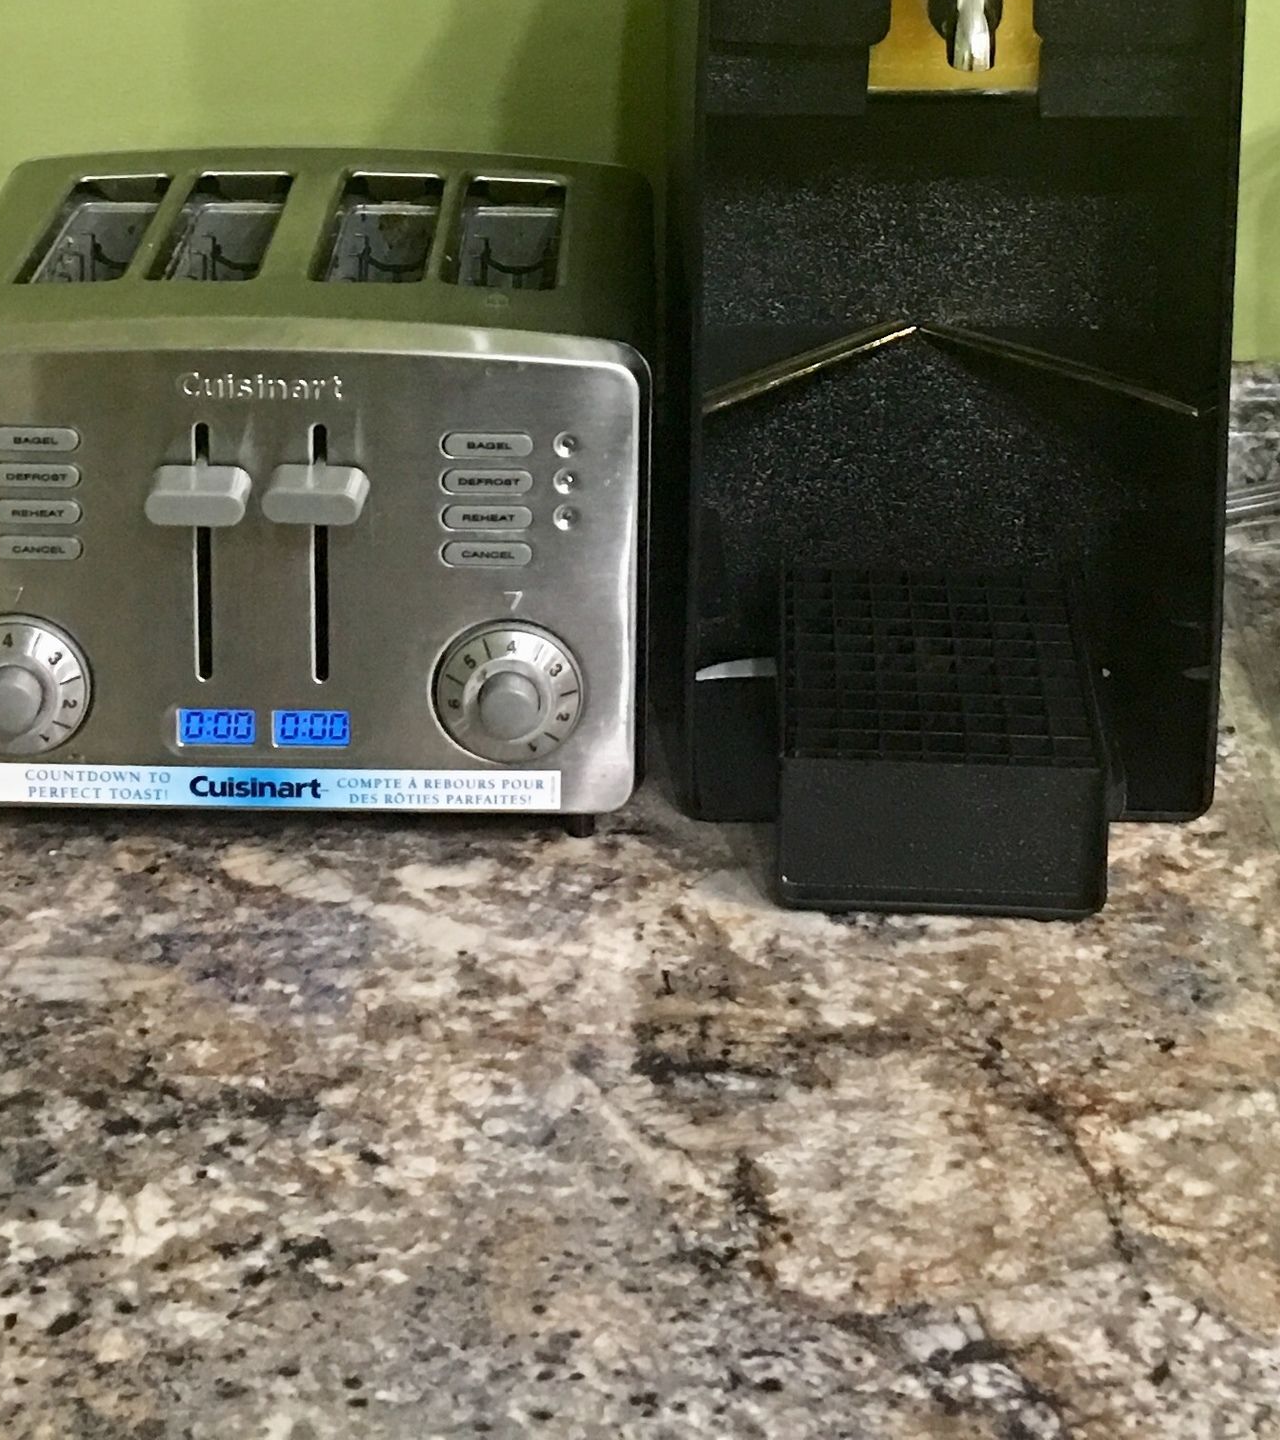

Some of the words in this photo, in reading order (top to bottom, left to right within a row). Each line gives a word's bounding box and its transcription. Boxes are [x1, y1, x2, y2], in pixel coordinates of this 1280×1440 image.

[176, 372, 342, 400] Cuisinart
[13, 436, 59, 445] BAGEL
[466, 441, 512, 450] BAGEL
[6, 473, 68, 482] DEFROST
[458, 477, 520, 486] DEFROST
[11, 509, 64, 518] REHEAT
[462, 513, 515, 522] REHEAT
[12, 545, 66, 554] CANCEL
[461, 550, 515, 559] CANCEL
[2, 633, 13, 648] 4
[506, 640, 517, 653] 4
[48, 651, 63, 665] 3
[463, 654, 477, 669] 5
[549, 663, 563, 677] 3
[62, 699, 78, 709] 2
[556, 712, 570, 722] 2
[185, 712, 253, 739] 0:00
[280, 713, 348, 740] 0:00
[25, 769, 140, 782] COUNTDOWN
[149, 771, 171, 783] TO
[189, 775, 321, 799] Cuisinart
[336, 777, 402, 789] COMPTE
[408, 777, 419, 789] À
[424, 778, 496, 790] REBOURS
[501, 779, 544, 790] POUR
[29, 786, 102, 799] PERFECT
[109, 787, 169, 800] TOAST!
[349, 793, 378, 804] DES
[384, 792, 442, 805] RÔTIES
[446, 793, 532, 805] PARFAITES!
